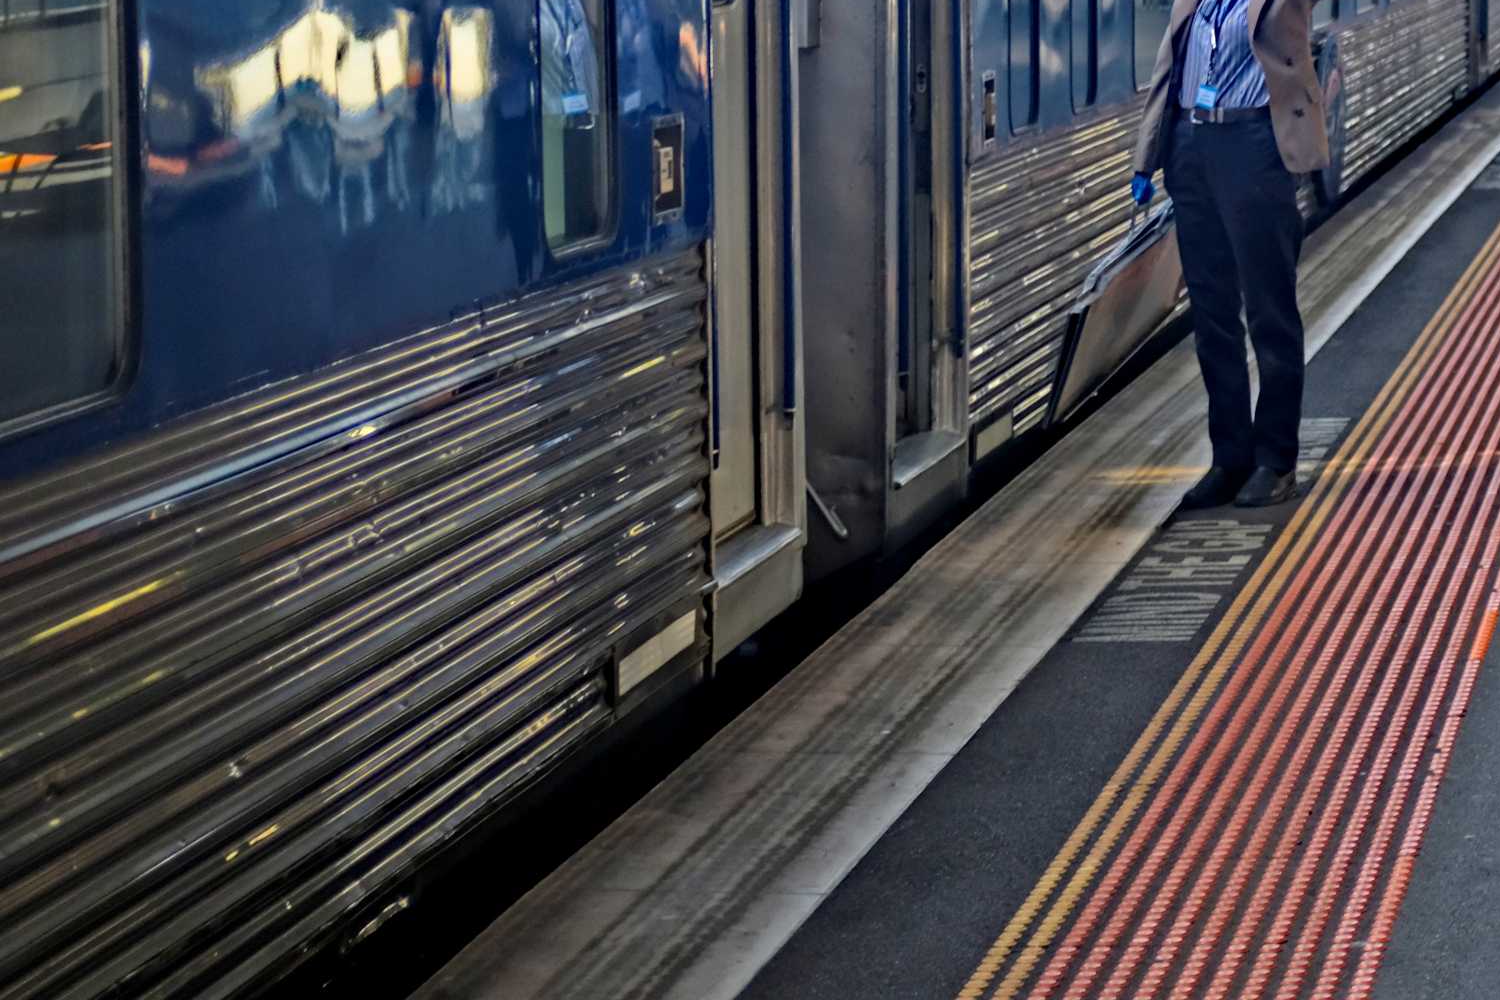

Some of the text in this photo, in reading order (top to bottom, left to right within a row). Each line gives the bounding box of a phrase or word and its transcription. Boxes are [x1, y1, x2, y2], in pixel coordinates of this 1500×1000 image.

[1071, 520, 1273, 641] MIND THE GAP
